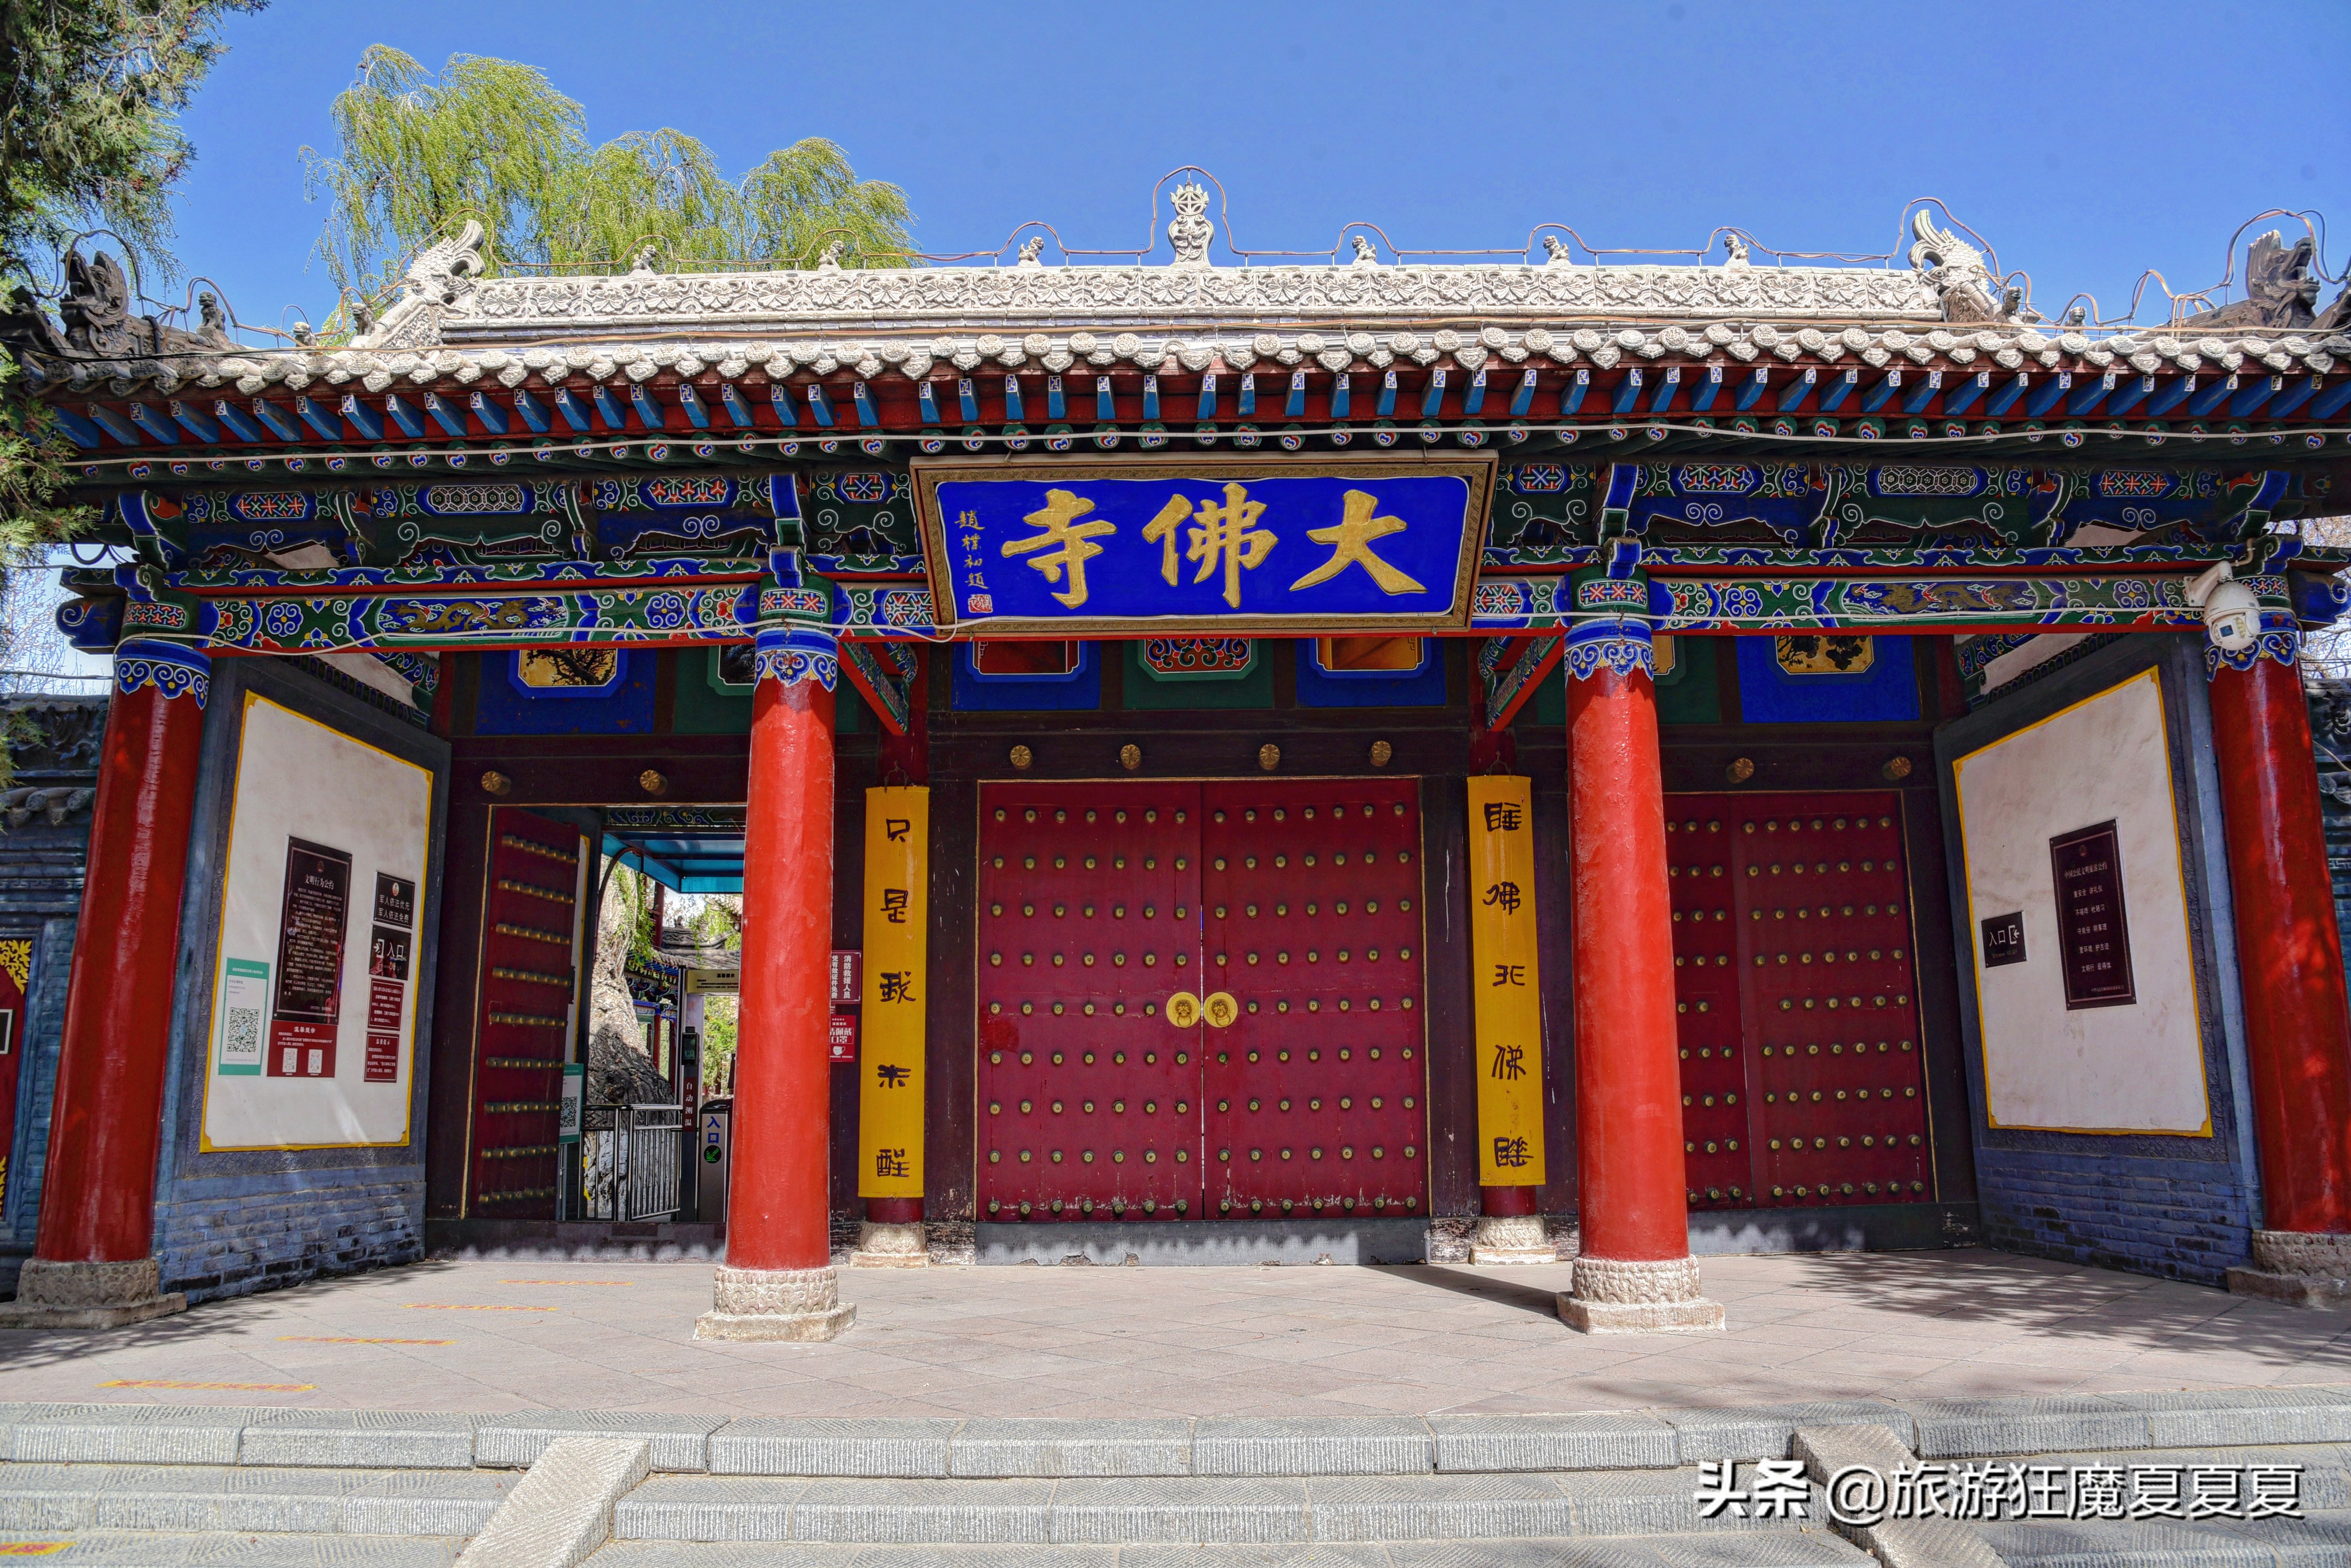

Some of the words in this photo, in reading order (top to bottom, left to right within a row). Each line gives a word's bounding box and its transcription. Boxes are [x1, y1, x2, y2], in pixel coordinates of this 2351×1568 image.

[1000, 482, 1427, 609] 大佛寺
[305, 874, 335, 890] 文明行为公约
[379, 894, 410, 911] 军人依法优先
[378, 907, 409, 923] 军人依法免费
[1989, 930, 2006, 947] 入口
[387, 942, 404, 958] 入口
[843, 954, 852, 999] 消防救援人员
[685, 1082, 693, 1127] 自动测温
[707, 1116, 721, 1144] 入口
